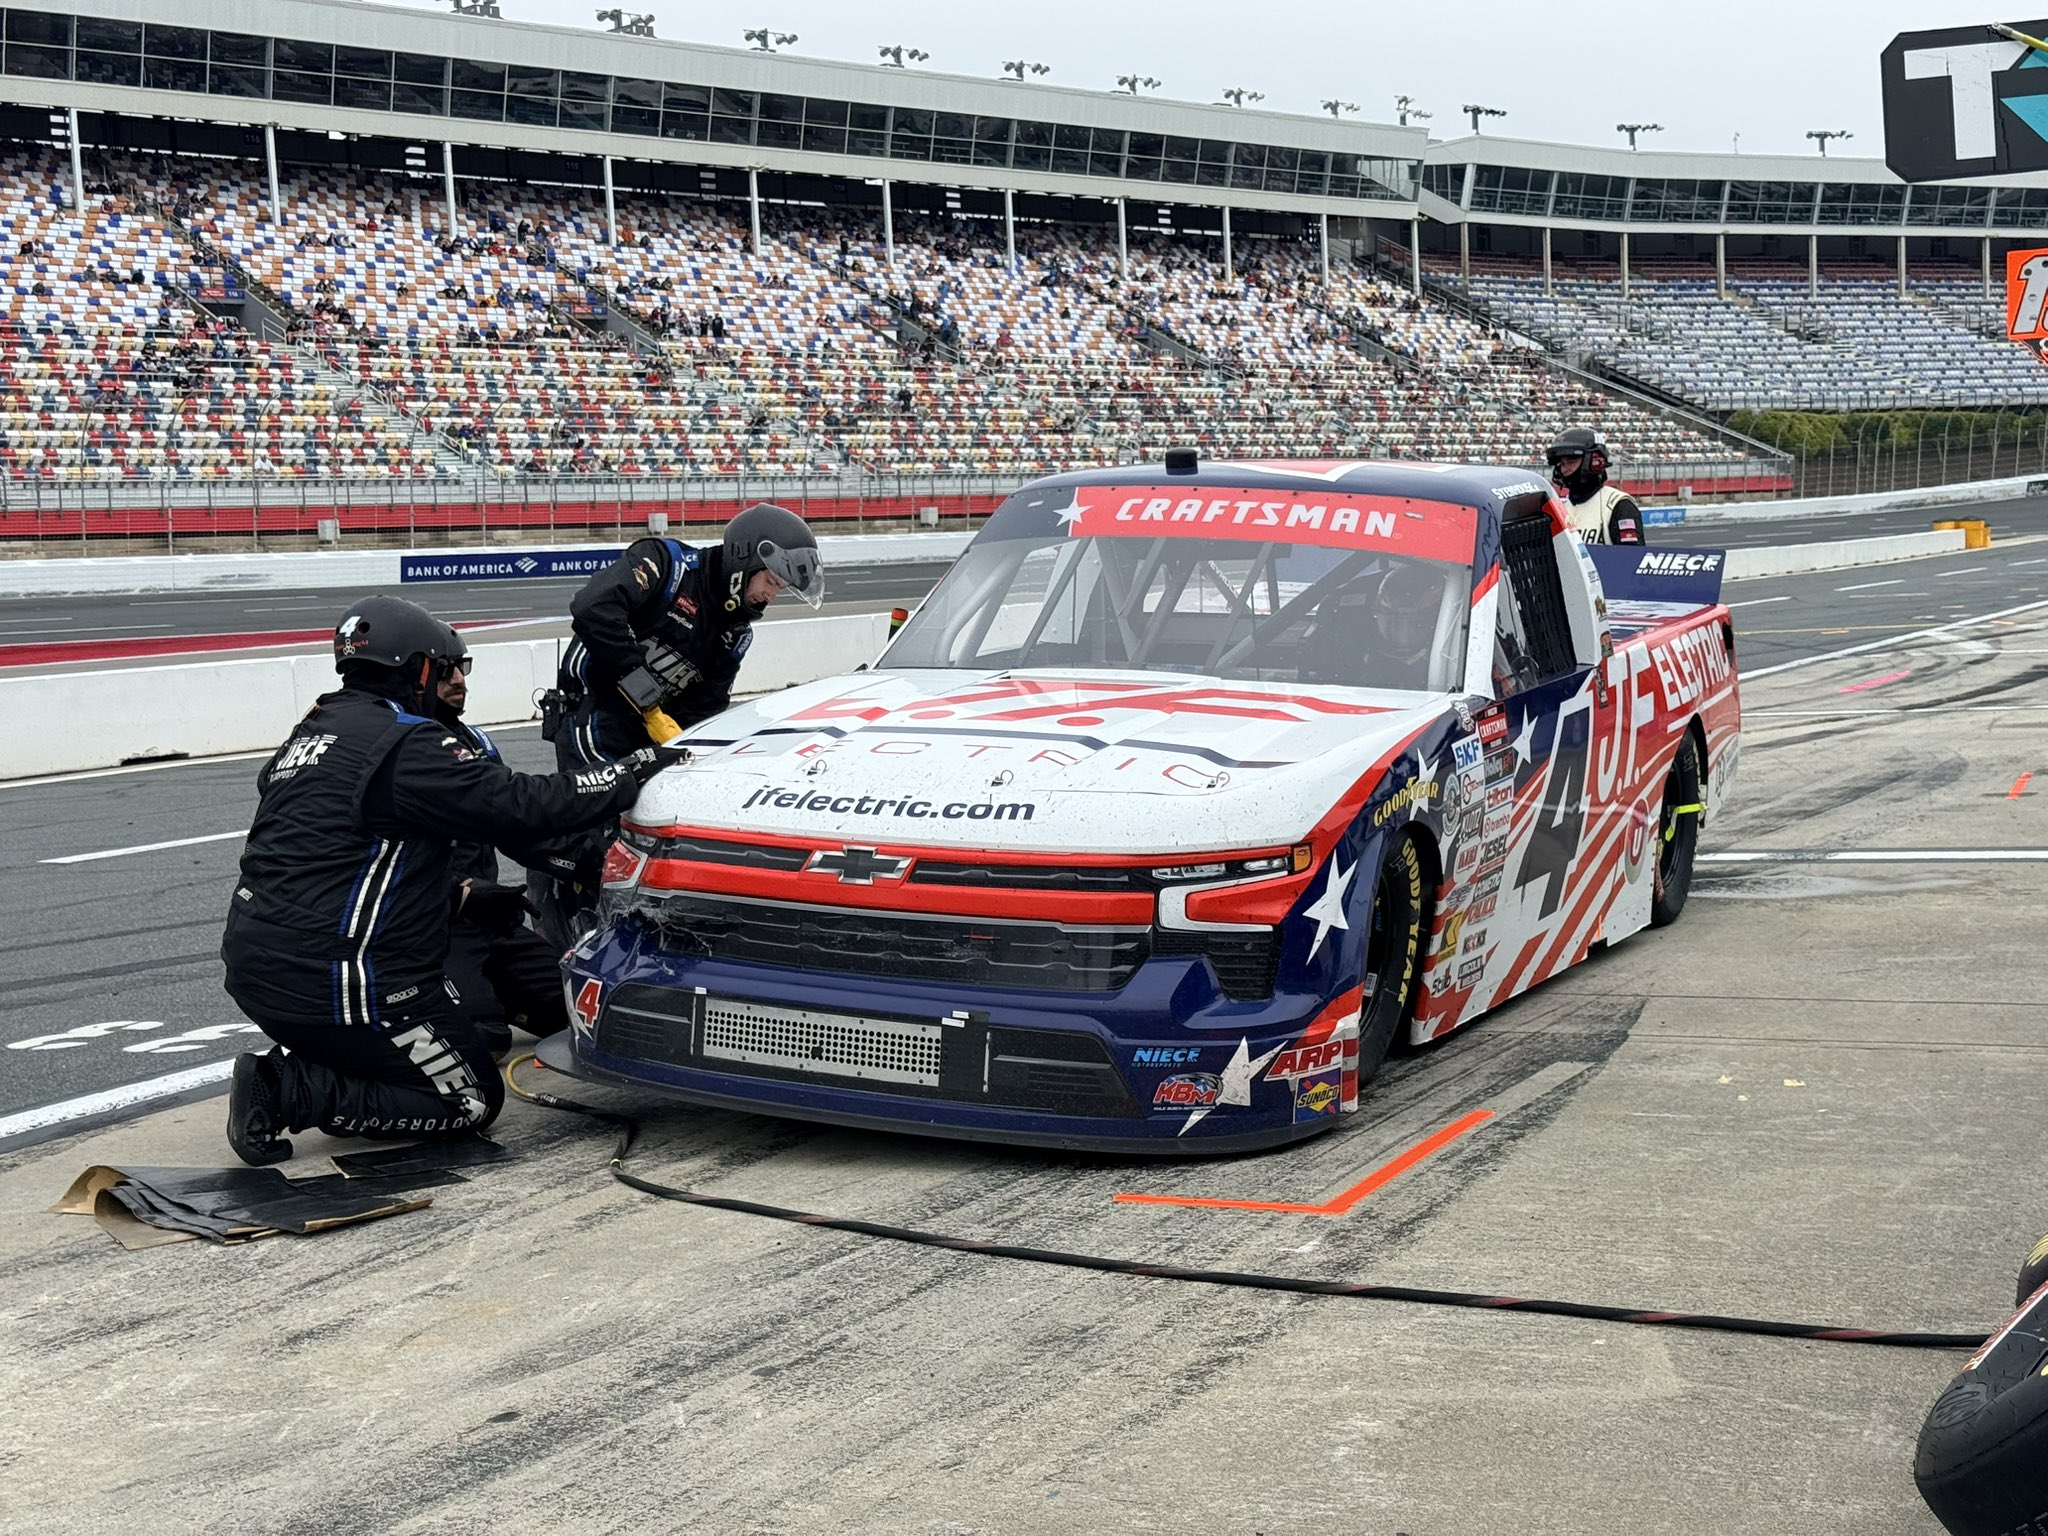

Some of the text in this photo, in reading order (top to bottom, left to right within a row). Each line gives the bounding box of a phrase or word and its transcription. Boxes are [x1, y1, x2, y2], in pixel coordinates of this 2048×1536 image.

[1115, 498, 1396, 538] CRAFTSMAN
[407, 563, 513, 577] BANK OF AMERICA
[551, 561, 581, 572] BANK
[584, 560, 599, 571] OF
[1635, 569, 1696, 577] MOTORSPORTS
[1639, 552, 1722, 571] NIECE
[340, 616, 361, 637] 4
[1650, 620, 1731, 712] ELECTRIC
[1454, 738, 1480, 770] SKF
[741, 785, 1035, 820] jfelectric.com
[1374, 776, 1438, 827] GOODYEAR
[1513, 705, 1591, 922] 4
[1491, 813, 1510, 832] brembo
[1397, 838, 1421, 1009] GOODYEAR
[386, 986, 419, 1004] sparco
[576, 978, 603, 1029] 4
[1132, 1047, 1201, 1063] NIECE
[1267, 1041, 1341, 1076] ARP
[1152, 1081, 1217, 1106] KBM
[1298, 1086, 1339, 1107] SUNOCO
